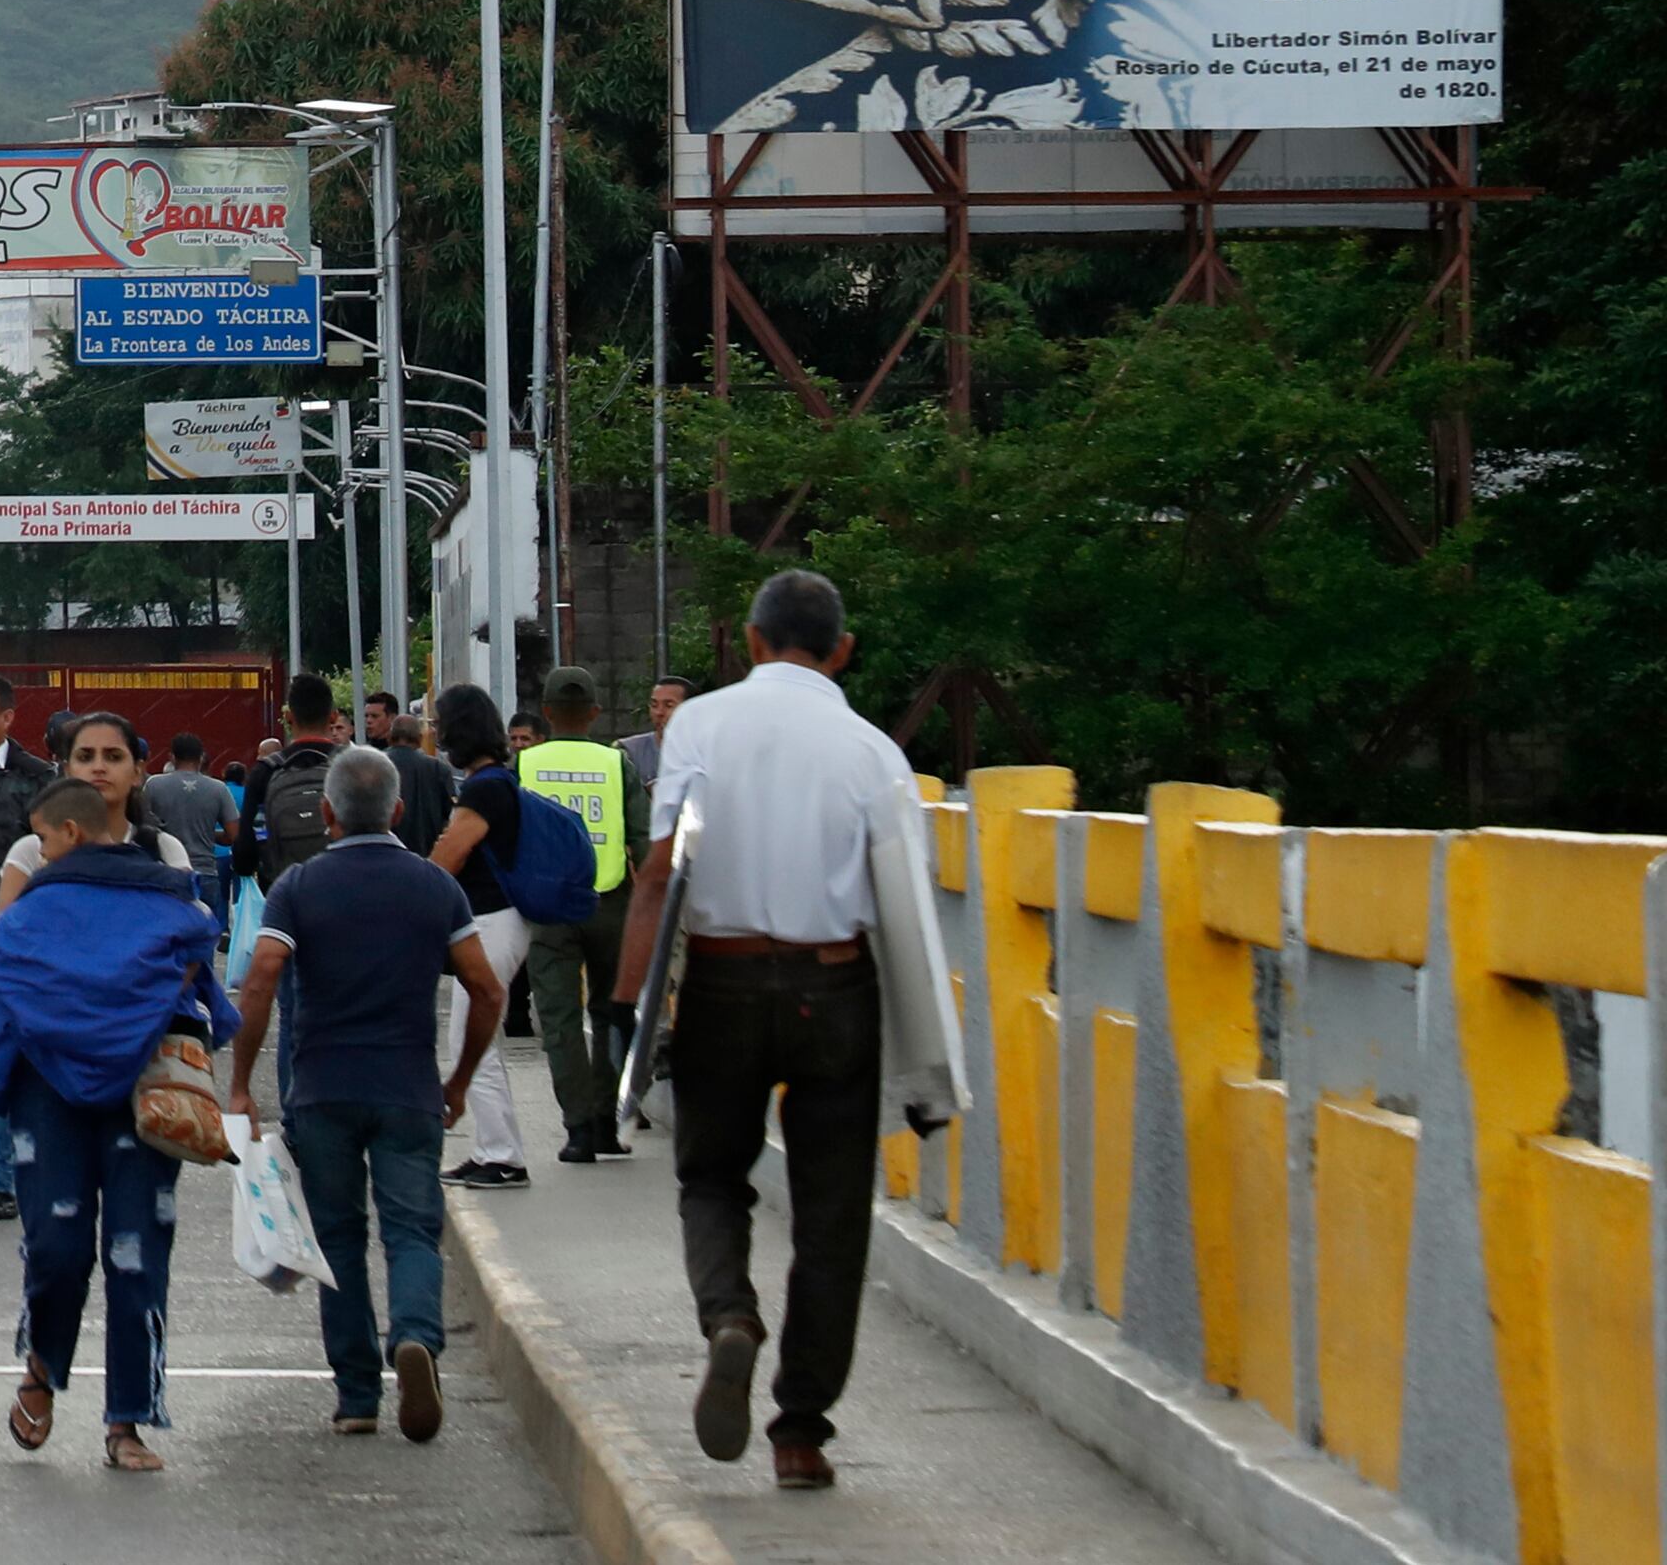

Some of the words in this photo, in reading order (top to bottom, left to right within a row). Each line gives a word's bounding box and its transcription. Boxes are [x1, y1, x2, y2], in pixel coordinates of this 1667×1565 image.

[1211, 32, 1331, 48] Libertador
[1338, 28, 1408, 47] Simón
[1416, 28, 1497, 46] Bolívar
[1115, 59, 1200, 75] Rosario
[1208, 59, 1234, 74] de
[1243, 57, 1330, 76] Cúcuta,
[1338, 56, 1358, 73] el
[1365, 56, 1392, 73] 21
[1400, 56, 1428, 73] de
[1436, 58, 1496, 75] mayo
[1399, 83, 1426, 98] de
[1435, 82, 1497, 98] 1820.
[165, 197, 287, 228] BOLÍVAR
[123, 283, 269, 298] BIENVENIDOS
[84, 310, 112, 326] AL
[123, 309, 203, 325] ESTADO
[216, 303, 311, 324] TÁCHIRA
[84, 337, 104, 353] La
[111, 337, 187, 353] Frontera
[196, 336, 216, 352] de
[225, 336, 254, 351] los
[262, 335, 311, 352] Andes
[197, 403, 246, 413] Táchira
[172, 415, 271, 436] Bienvenidos
[169, 444, 181, 454] a
[187, 434, 277, 458] Venezuela
[52, 501, 82, 516] San
[86, 500, 147, 515] Antonio
[152, 500, 177, 515] del
[180, 499, 241, 515] Táchira
[265, 506, 273, 518] 5
[20, 521, 58, 536] Zona
[64, 520, 132, 536] Primaria
